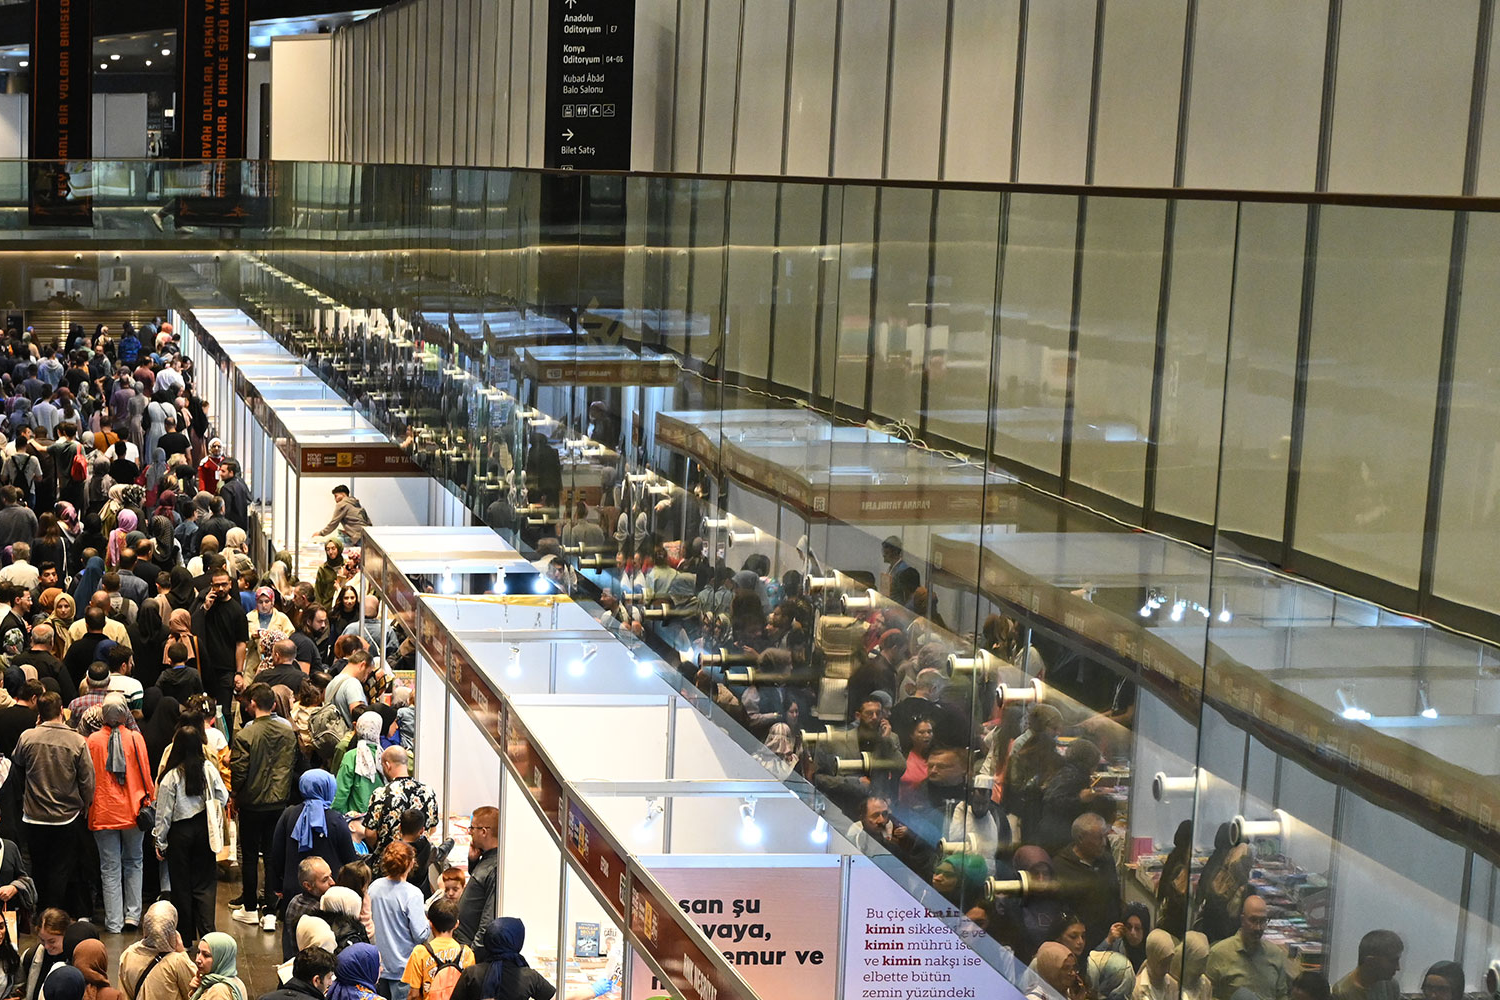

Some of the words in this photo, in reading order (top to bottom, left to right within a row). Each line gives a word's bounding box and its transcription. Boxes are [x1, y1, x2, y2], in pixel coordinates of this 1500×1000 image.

[564, 14, 594, 22] Anadolu
[563, 25, 602, 35] Oditoryum
[563, 44, 586, 53] Konya
[563, 55, 601, 65] Oditoryum
[59, 52, 69, 100] YOLDAN
[218, 57, 228, 95] HALDE
[563, 73, 586, 83] Kubad
[562, 85, 579, 94] Balo
[580, 85, 604, 94] Salonu
[561, 145, 577, 155] Bilet
[578, 145, 596, 156] Satış
[679, 899, 723, 914] san
[732, 899, 761, 918] şu
[866, 908, 884, 919] Bu
[887, 908, 921, 922] çiçek
[865, 924, 905, 935] kimin
[864, 939, 904, 950] kimin
[907, 940, 952, 952] mührü
[723, 951, 786, 965] emur
[795, 951, 824, 965] ve
[864, 957, 879, 966] ve
[882, 955, 921, 967] kimin
[924, 956, 960, 968] nakşı
[963, 956, 982, 966] ise
[863, 971, 908, 982] elbette
[911, 971, 951, 982] bütün
[862, 987, 902, 998] zemin
[906, 987, 976, 1000] yüzündeki
